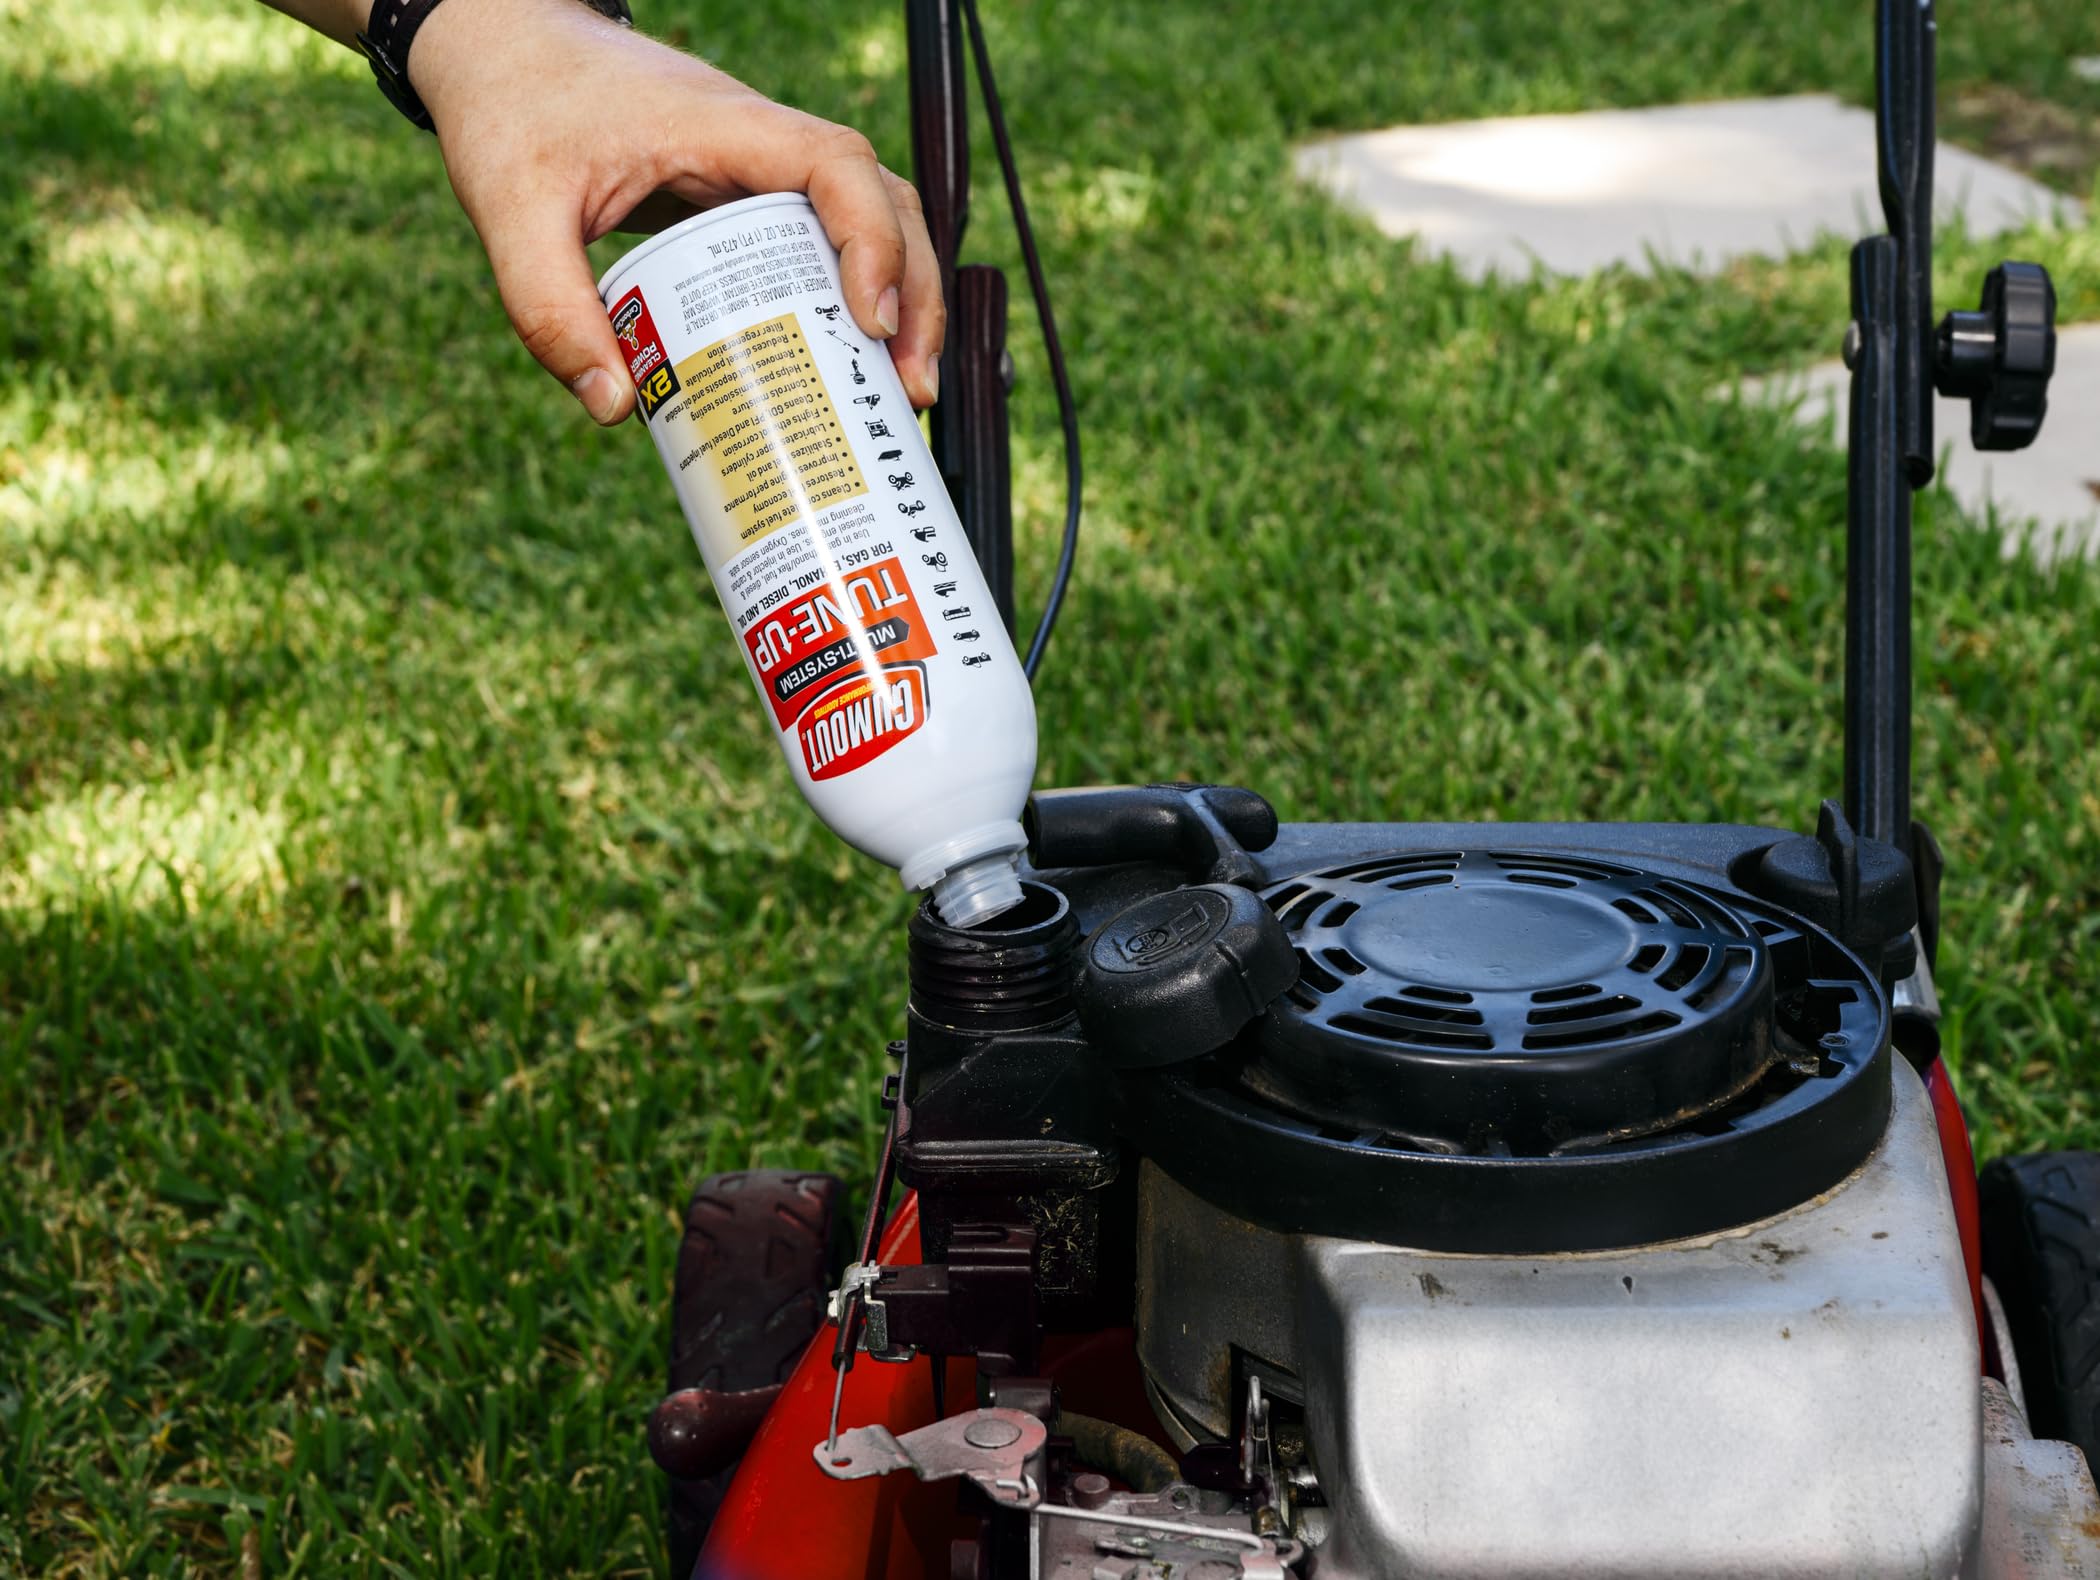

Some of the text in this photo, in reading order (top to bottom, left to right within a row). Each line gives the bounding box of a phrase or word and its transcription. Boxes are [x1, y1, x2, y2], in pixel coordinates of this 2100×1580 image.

[763, 226, 776, 240] OZ
[774, 224, 786, 236] FL
[784, 223, 795, 235] 16
[794, 222, 809, 234] NET
[721, 237, 738, 253] 473
[736, 232, 754, 247] PT)
[706, 242, 721, 258] mL
[751, 263, 765, 275] AND
[775, 269, 791, 281] SKIN
[748, 277, 763, 290] EYE
[761, 273, 776, 285] AND
[688, 288, 701, 302] OUT
[700, 281, 717, 296] KEEP
[679, 295, 689, 307] OF
[685, 276, 832, 334] DANGER: FLAMMABLE. HARMFUL OR FATAL IF
[694, 295, 720, 313] VAPORS
[682, 305, 696, 320] MAY
[706, 321, 783, 358] filter regeneration
[629, 341, 656, 372] POWER
[684, 333, 788, 387] Reduces diesel particulate
[633, 351, 661, 382] CLEANING
[639, 367, 673, 410] 2X
[664, 348, 795, 423] Removes fuel deposits and oil residue
[690, 363, 801, 421] Helps pass emissions testing
[731, 378, 807, 415] Controls moisture
[783, 393, 813, 409] Cleans
[750, 412, 765, 425] PFI
[791, 408, 819, 423] Fights
[734, 419, 750, 433] and
[779, 422, 826, 445] Lubricates
[711, 427, 735, 446] Diesel
[722, 433, 759, 456] corrosion
[699, 440, 712, 455] fuel
[790, 437, 832, 459] Stabilizes
[679, 448, 700, 471] injectors
[720, 453, 754, 476] cylinders
[797, 453, 838, 473] Improves
[746, 470, 756, 481] oil
[757, 462, 772, 476] and
[805, 468, 845, 487] Restores
[723, 479, 769, 512] performance
[820, 483, 851, 498] Cleans
[753, 490, 787, 513] economy
[765, 511, 782, 526] fuel
[829, 503, 864, 519] cleaning
[740, 519, 765, 539] system
[838, 513, 875, 532] biodiesel
[842, 534, 852, 543] in
[852, 528, 870, 540] Use
[760, 535, 787, 554] Oxygen
[785, 542, 801, 554] Use
[740, 550, 759, 569] sensor
[777, 551, 785, 559] in
[753, 555, 777, 575] injector
[730, 574, 746, 591] carbon
[746, 569, 752, 580] &
[760, 569, 777, 584] fuel,
[736, 540, 893, 628] FOR GAS, EHANOL, DIESEL AND OIL
[744, 579, 760, 597] diesel
[740, 590, 745, 600] &
[755, 568, 908, 672] TUNE-UP
[779, 623, 896, 693] MUTI-SYSTEM
